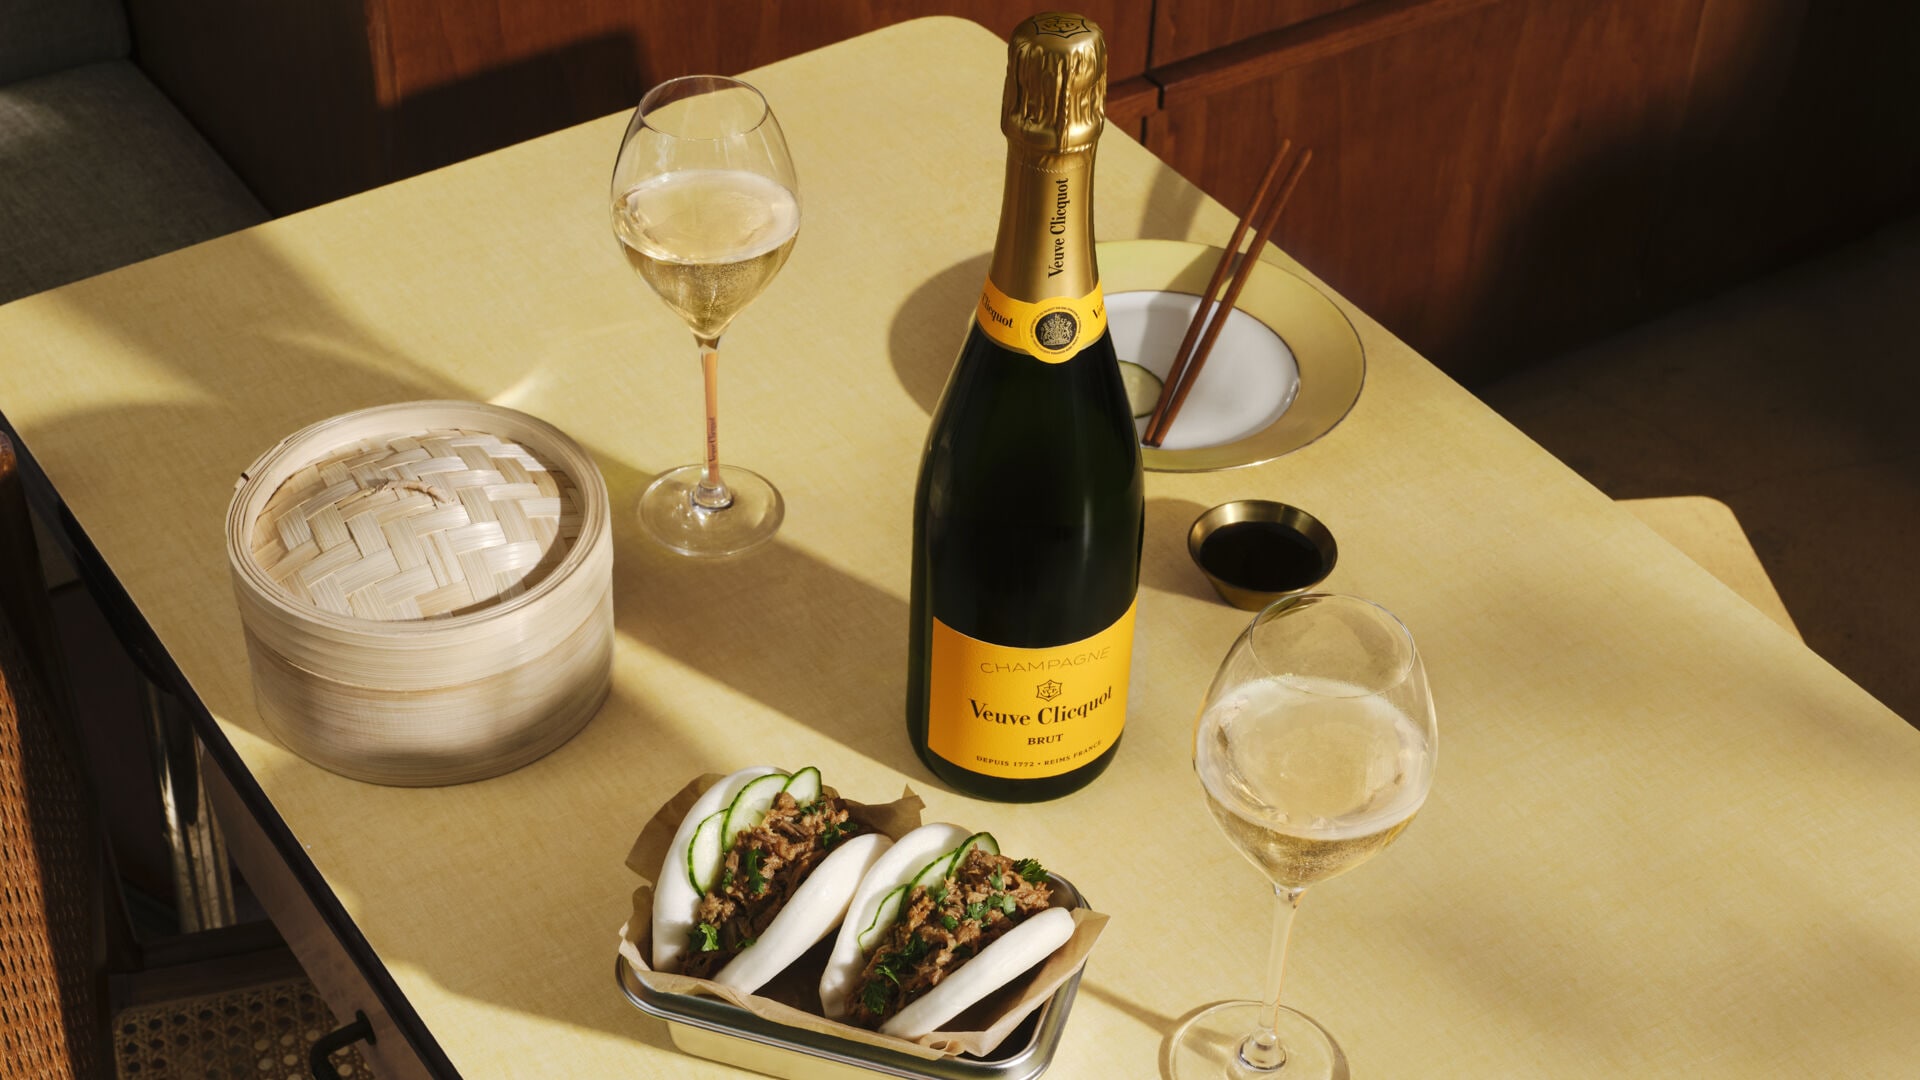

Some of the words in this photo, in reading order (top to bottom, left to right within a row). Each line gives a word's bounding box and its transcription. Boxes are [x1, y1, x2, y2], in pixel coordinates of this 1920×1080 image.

[1049, 178, 1071, 235] Clicquot
[1047, 238, 1065, 279] Veuve
[980, 646, 1111, 674] CHAMPAGNE
[968, 698, 1031, 726] Veuve
[1037, 685, 1113, 726] Clicquot
[976, 755, 1010, 767] DEPUIS
[1044, 755, 1072, 767] REIMS
[1073, 740, 1102, 759] FRANCE
[1027, 733, 1064, 746] BRUT
